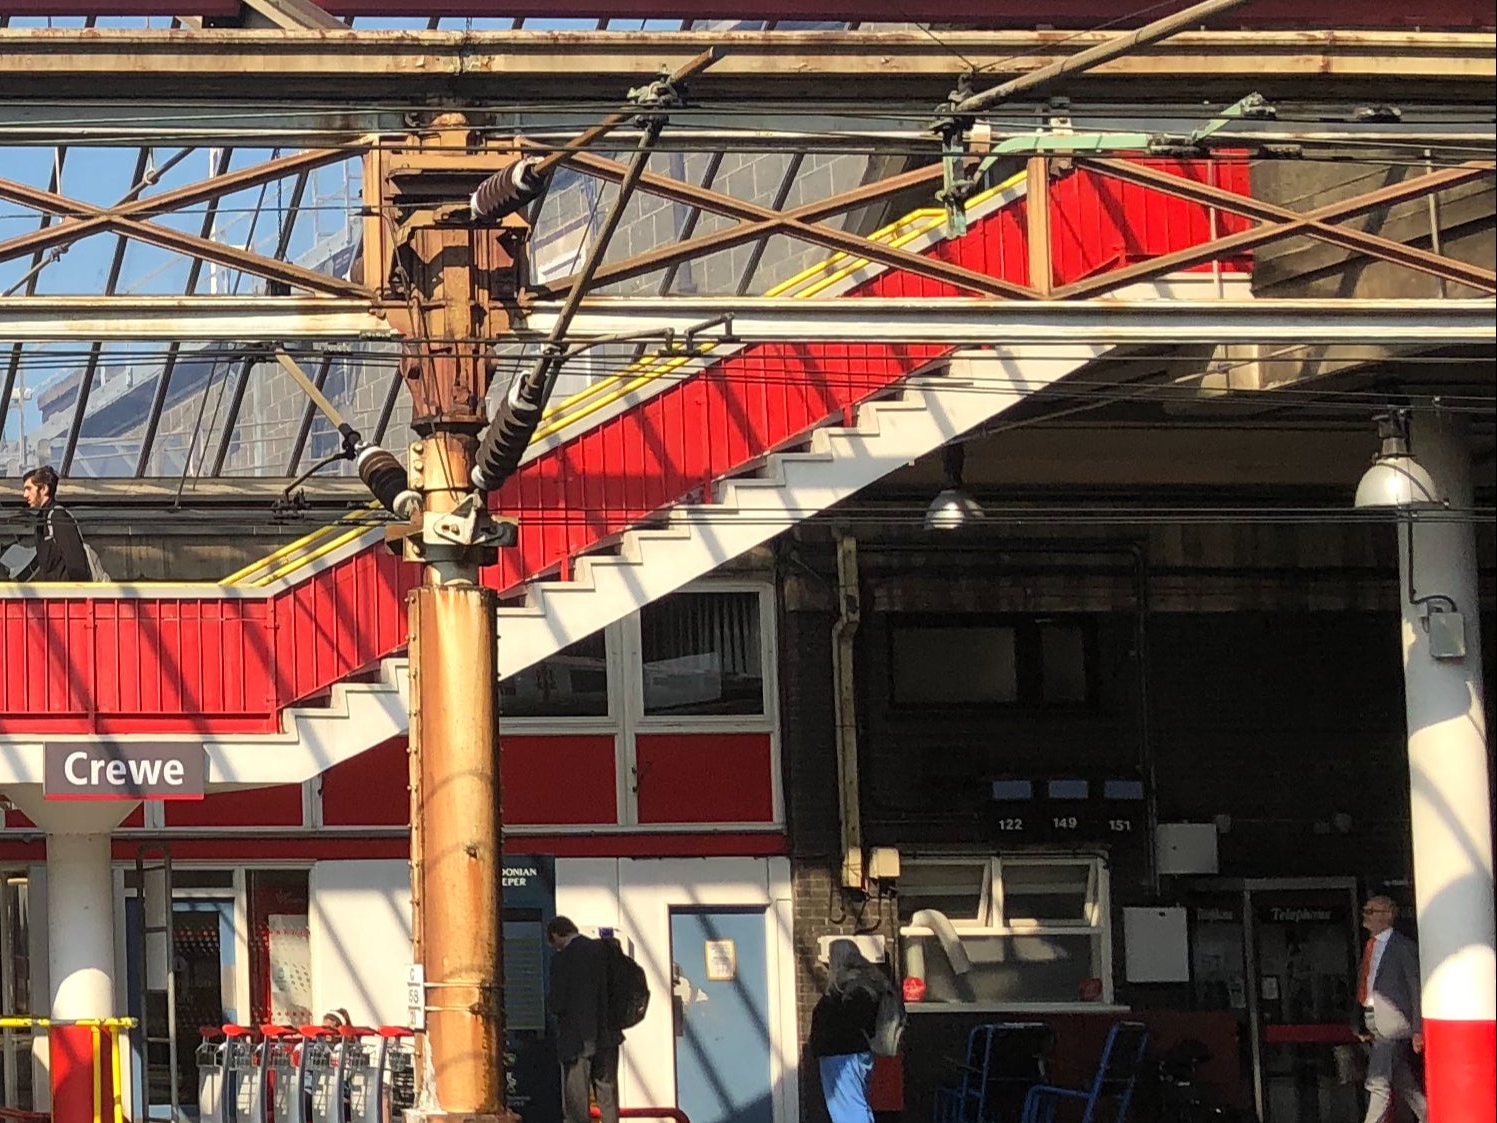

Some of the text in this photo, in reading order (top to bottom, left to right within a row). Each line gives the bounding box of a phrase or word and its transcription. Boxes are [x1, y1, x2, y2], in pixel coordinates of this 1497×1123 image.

[64, 751, 184, 786] Crewe
[999, 818, 1023, 831] 122
[1054, 817, 1078, 829] 149
[1109, 819, 1132, 832] 151
